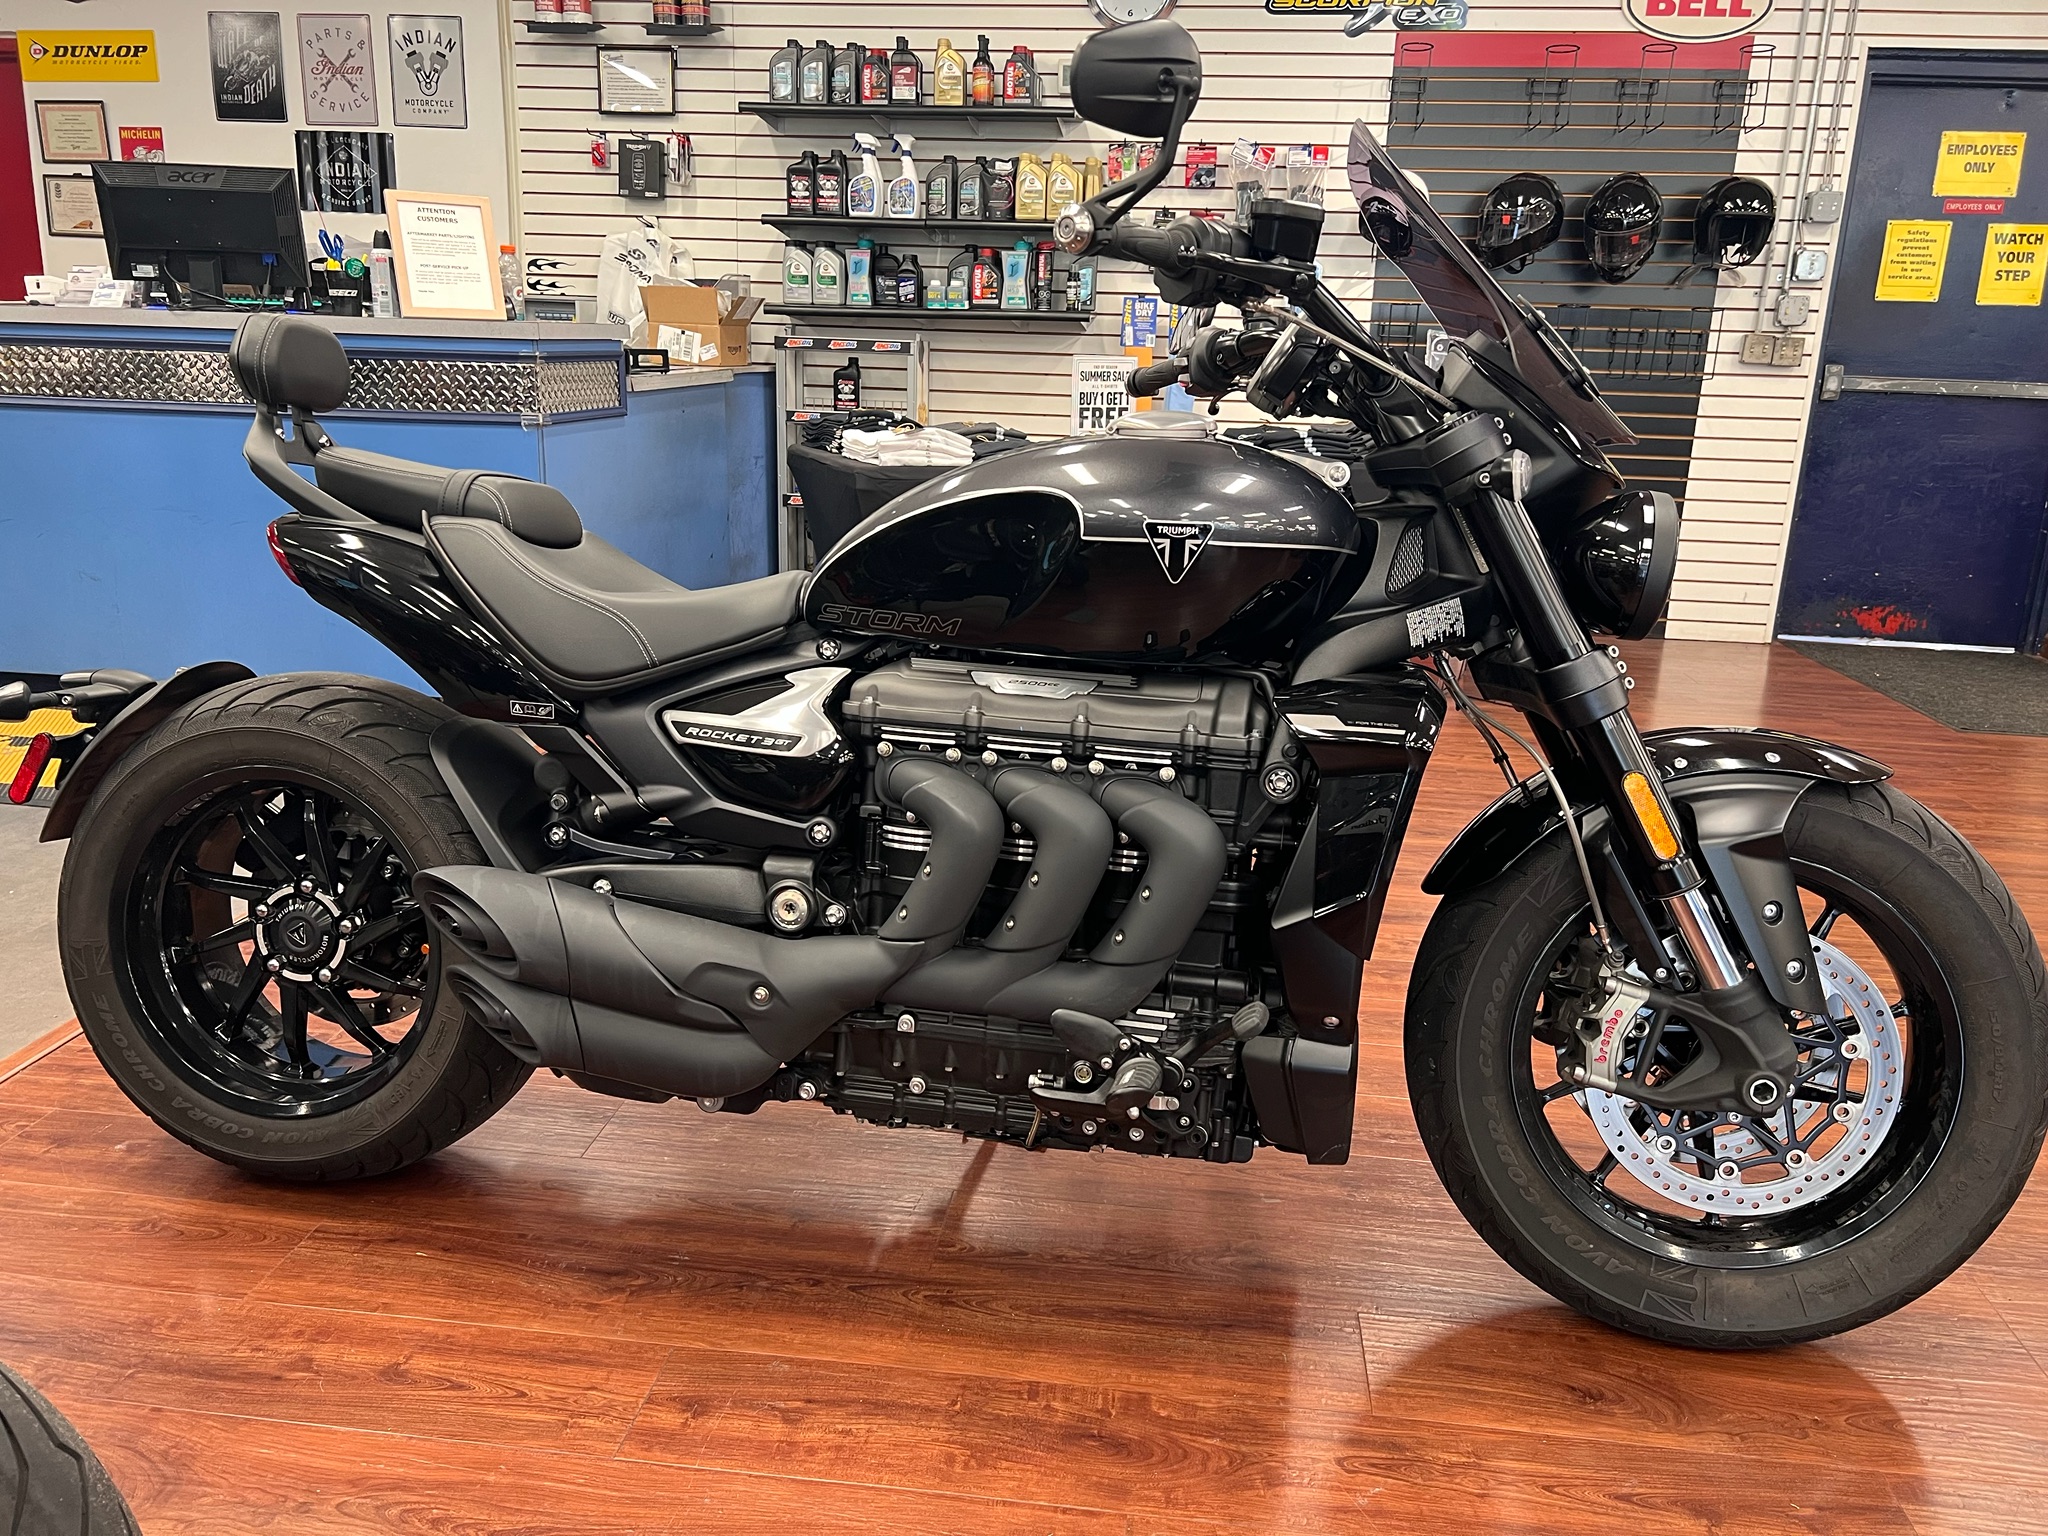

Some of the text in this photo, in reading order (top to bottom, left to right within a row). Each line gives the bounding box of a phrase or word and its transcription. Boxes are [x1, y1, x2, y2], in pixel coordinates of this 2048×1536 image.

[1127, 9, 1134, 17] 6
[1645, 0, 1752, 17] BELL
[306, 27, 353, 49] PARTS
[394, 29, 457, 53] INDIAN
[51, 45, 149, 58] DUNLOP
[310, 58, 364, 76] Indian
[243, 63, 276, 105] DEATH
[220, 93, 243, 101] INDIAN
[310, 90, 370, 112] SERVICE
[404, 98, 454, 108] MOTORCYCLE
[120, 129, 161, 140] MICHELIN
[1946, 144, 2018, 156] EMPLOYEES
[320, 161, 371, 178] INDIAN
[1963, 162, 1996, 173] ONLY
[167, 170, 216, 183] acer
[416, 207, 457, 216] ATTENTION
[1946, 203, 2002, 211] EMPLOYEES ONLY
[416, 215, 459, 224] CUSTOMERS
[1907, 229, 1931, 237] Safety
[1994, 232, 2045, 246] WATCH
[1997, 251, 2036, 264] YOUR
[1994, 269, 2031, 282] STEP
[974, 268, 983, 297] MOTUL
[1135, 302, 1155, 310] BIKE
[787, 339, 813, 347] AMSOIL
[1079, 370, 1112, 382] SUMMER
[1079, 391, 1130, 406] BUY 1 GET 1
[1156, 525, 1199, 537] TRIUMPH
[816, 602, 963, 637] STORM
[684, 726, 762, 745] ROCKET
[274, 903, 306, 922] TRIUMPH
[91, 990, 166, 1093] CHROME
[1594, 1009, 1624, 1064] brembo
[1478, 921, 1637, 1276] AVON COBRA CHROME
[171, 1096, 256, 1140] COBRA
